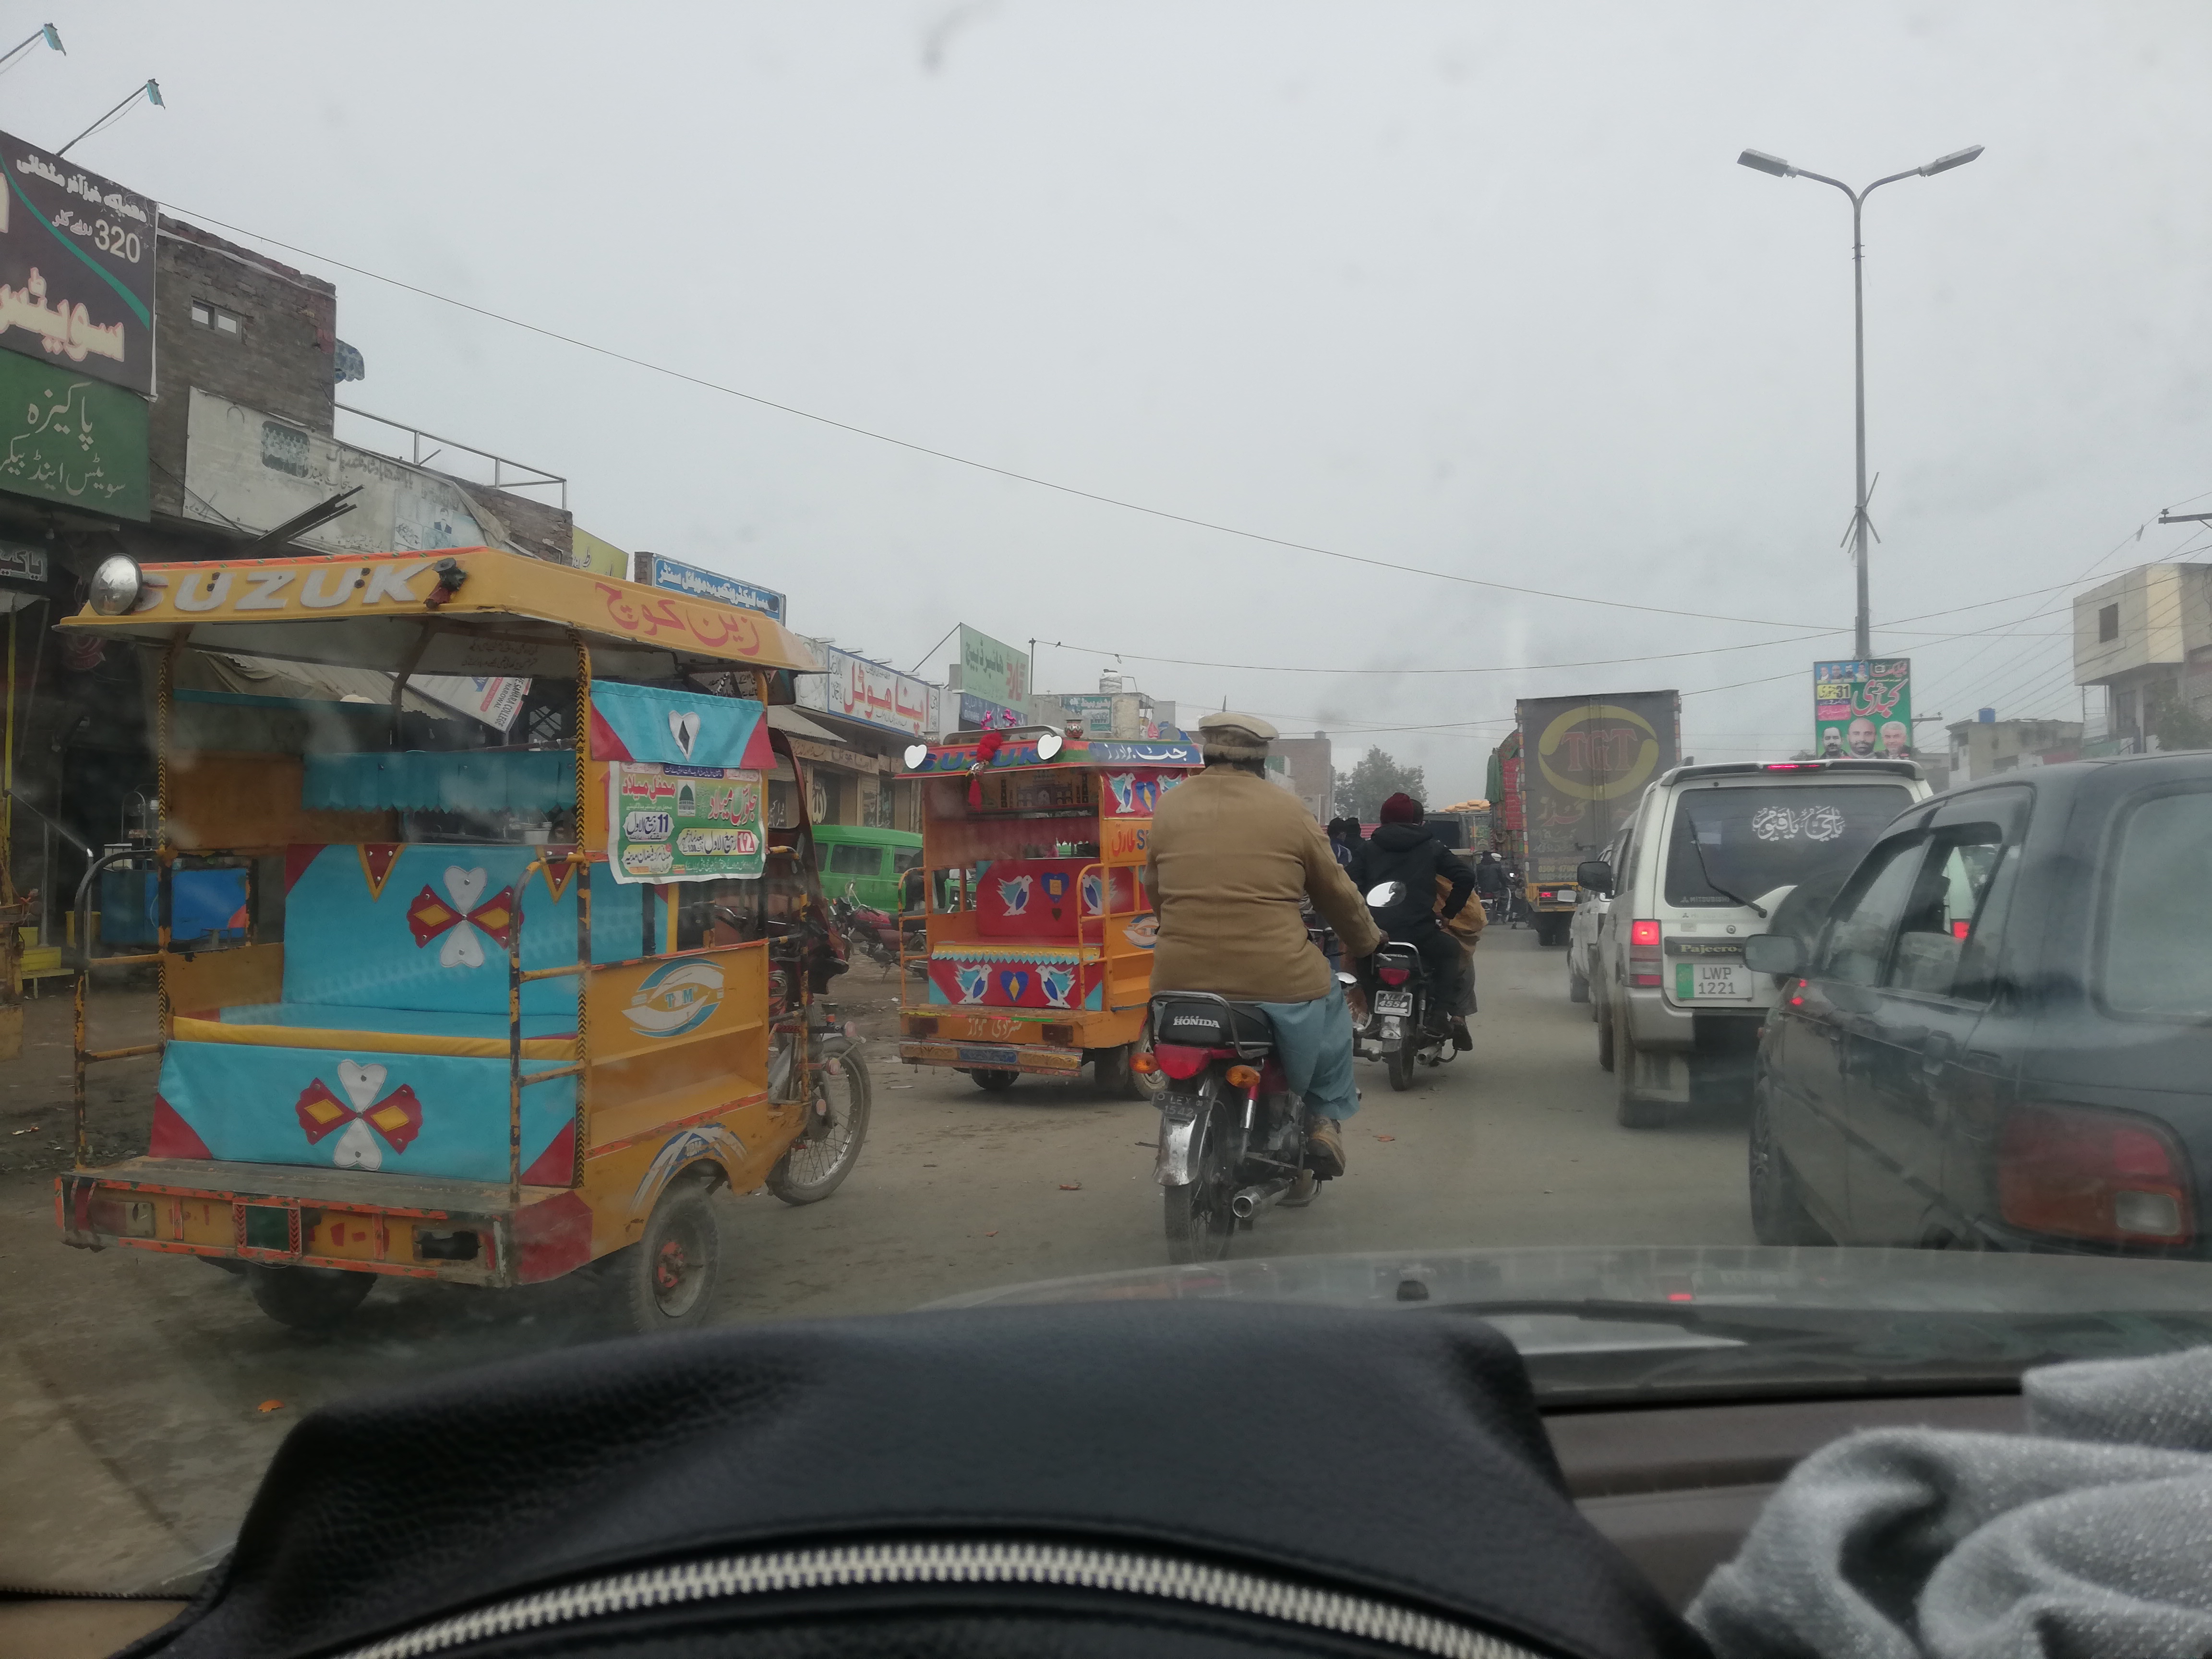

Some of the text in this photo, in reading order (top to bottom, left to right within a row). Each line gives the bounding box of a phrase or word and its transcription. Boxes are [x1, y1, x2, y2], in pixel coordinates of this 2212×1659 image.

[52, 209, 74, 228] کلو
[94, 219, 141, 264] 320
[27, 381, 95, 451] پاکیزہ
[27, 449, 64, 491] اینڈ
[66, 453, 126, 498] سویٹس
[133, 561, 434, 613] SUZUK
[595, 582, 760, 656] زین کوچ
[493, 682, 513, 709] NAROWAL
[1836, 685, 1849, 698] 31
[1851, 679, 1908, 718] کبڈی
[895, 676, 930, 738] اپنا
[916, 747, 1042, 771] SUUK
[1560, 728, 1638, 771] TGT
[622, 773, 649, 801] میلاد
[708, 788, 733, 821] میلاد
[658, 814, 669, 832] 11
[738, 833, 754, 852] 12
[1702, 967, 1732, 980] LWP
[665, 987, 694, 1009] TM
[1698, 982, 1736, 994] 1221
[1173, 1018, 1221, 1029] HONDA
[1165, 1105, 1194, 1118] 1542
[1170, 1094, 1192, 1106] LEX
